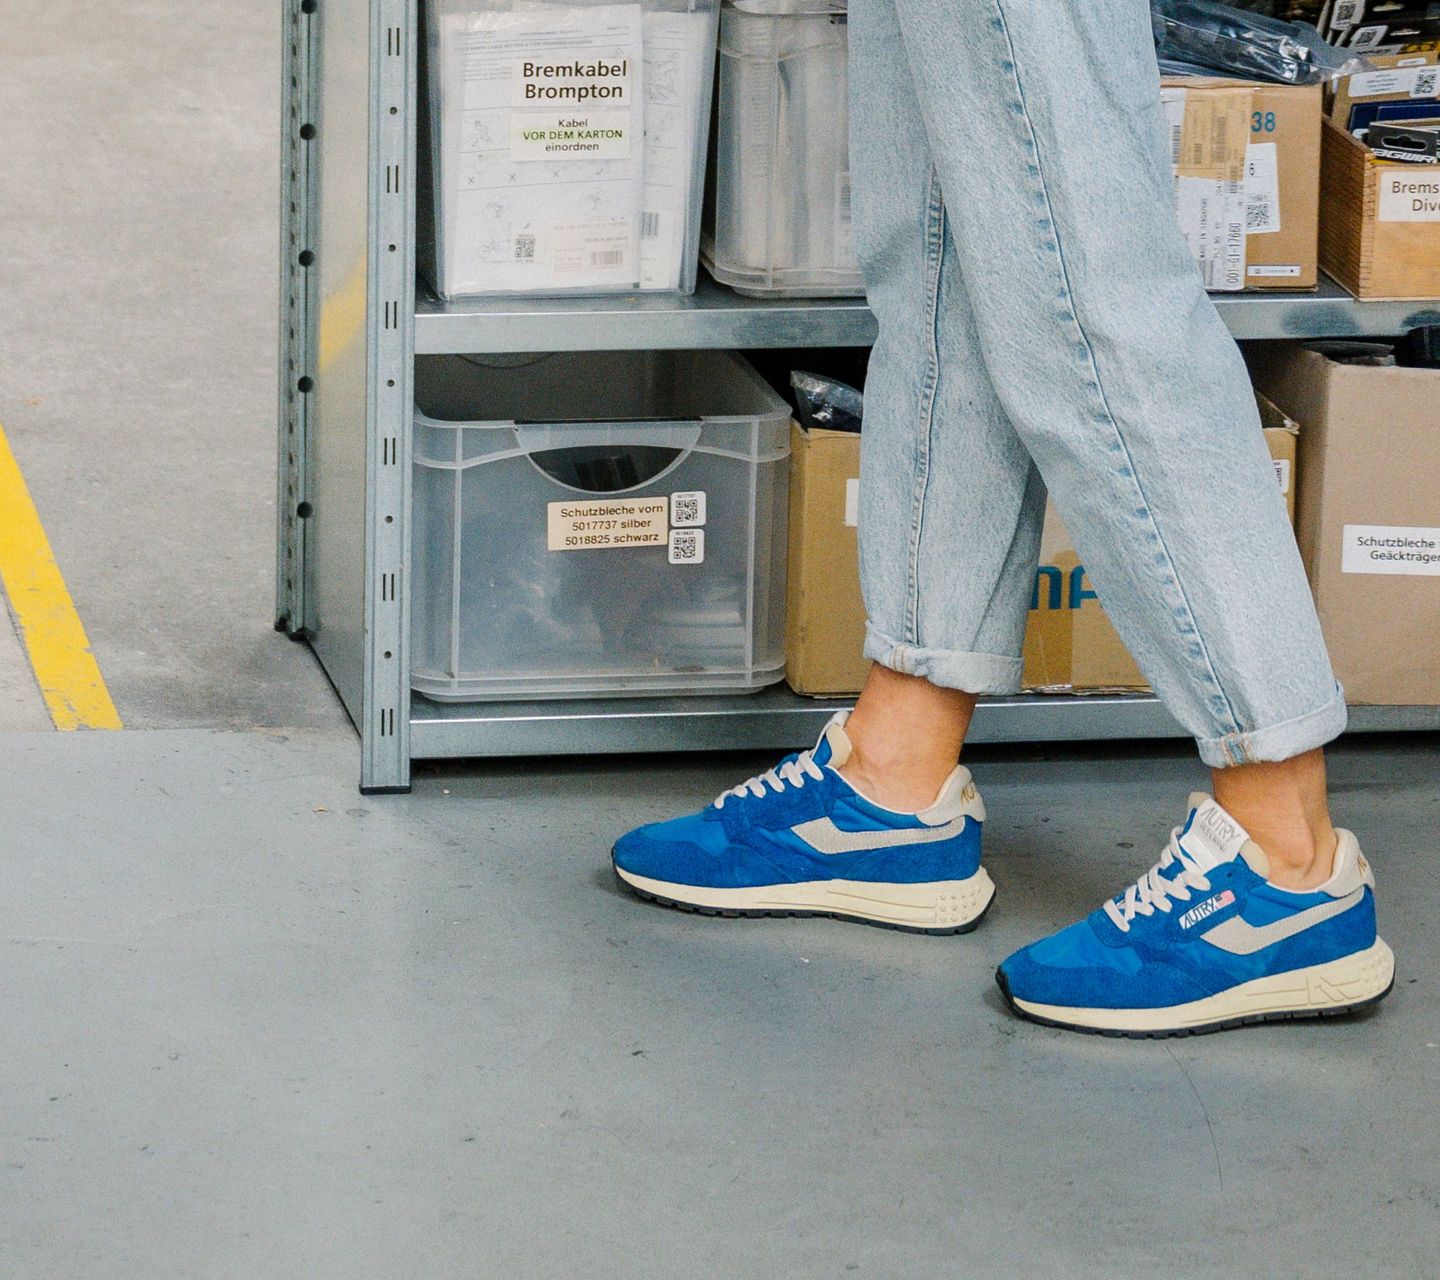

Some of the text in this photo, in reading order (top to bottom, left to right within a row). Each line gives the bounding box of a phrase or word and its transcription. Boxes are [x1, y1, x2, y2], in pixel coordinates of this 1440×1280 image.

[522, 60, 627, 78] Bremkabel
[525, 83, 624, 102] Brompton
[558, 118, 589, 128] Kabel
[1251, 111, 1277, 133] 38
[522, 129, 623, 141] VOR DEM KARTON
[545, 142, 600, 152] einordnen
[560, 505, 663, 519] Schutzbleche vorn
[572, 519, 652, 531] 5017737 silber
[565, 533, 659, 546] 5018825 schwarz
[1356, 535, 1436, 549] Schutzbleche
[1200, 806, 1242, 840] AUTRY
[1183, 899, 1217, 929] AUTRY
